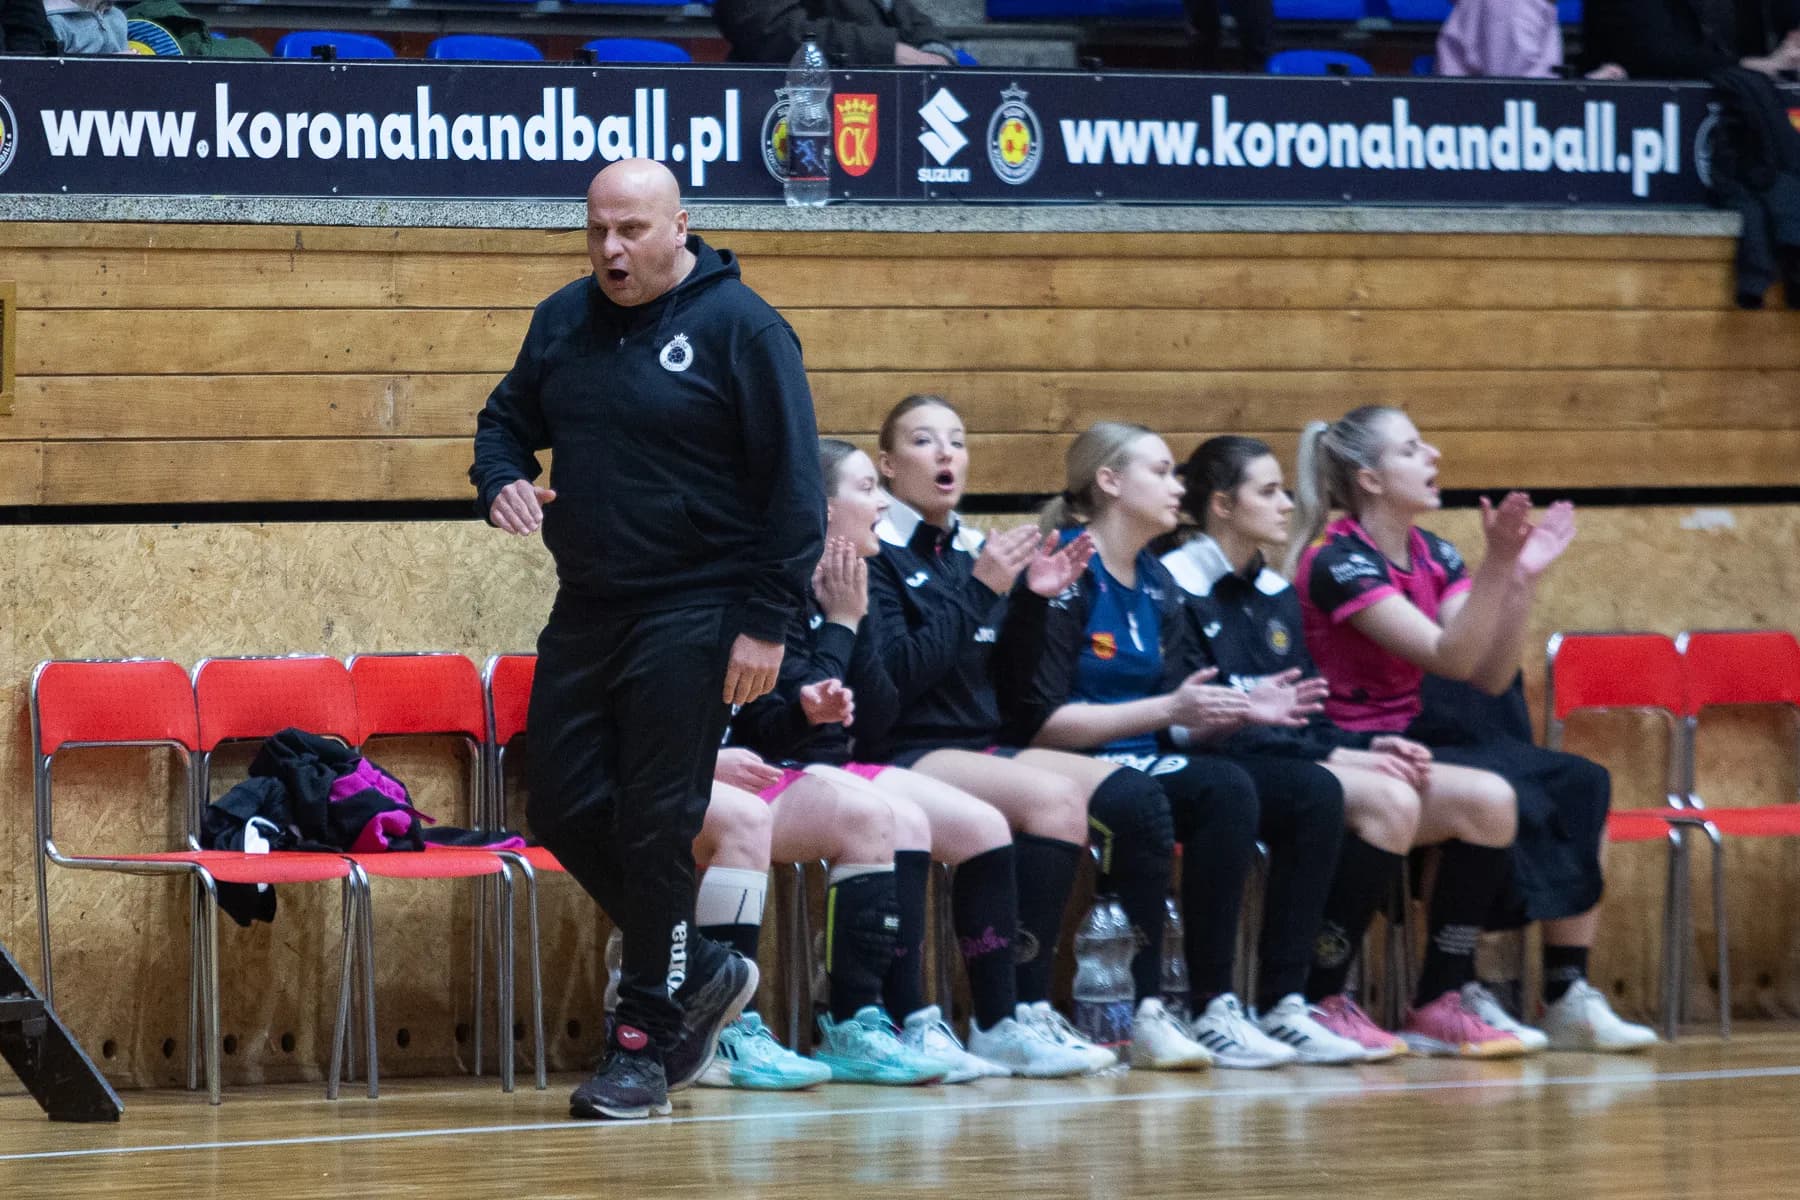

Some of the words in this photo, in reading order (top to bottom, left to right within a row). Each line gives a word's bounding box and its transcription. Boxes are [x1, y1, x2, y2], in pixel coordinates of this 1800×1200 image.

[40, 82, 741, 187] www.koronahandball.pl
[838, 126, 870, 166] CK
[1060, 94, 1681, 197] www.koronahandball.pl
[917, 167, 971, 184] SUZUKI
